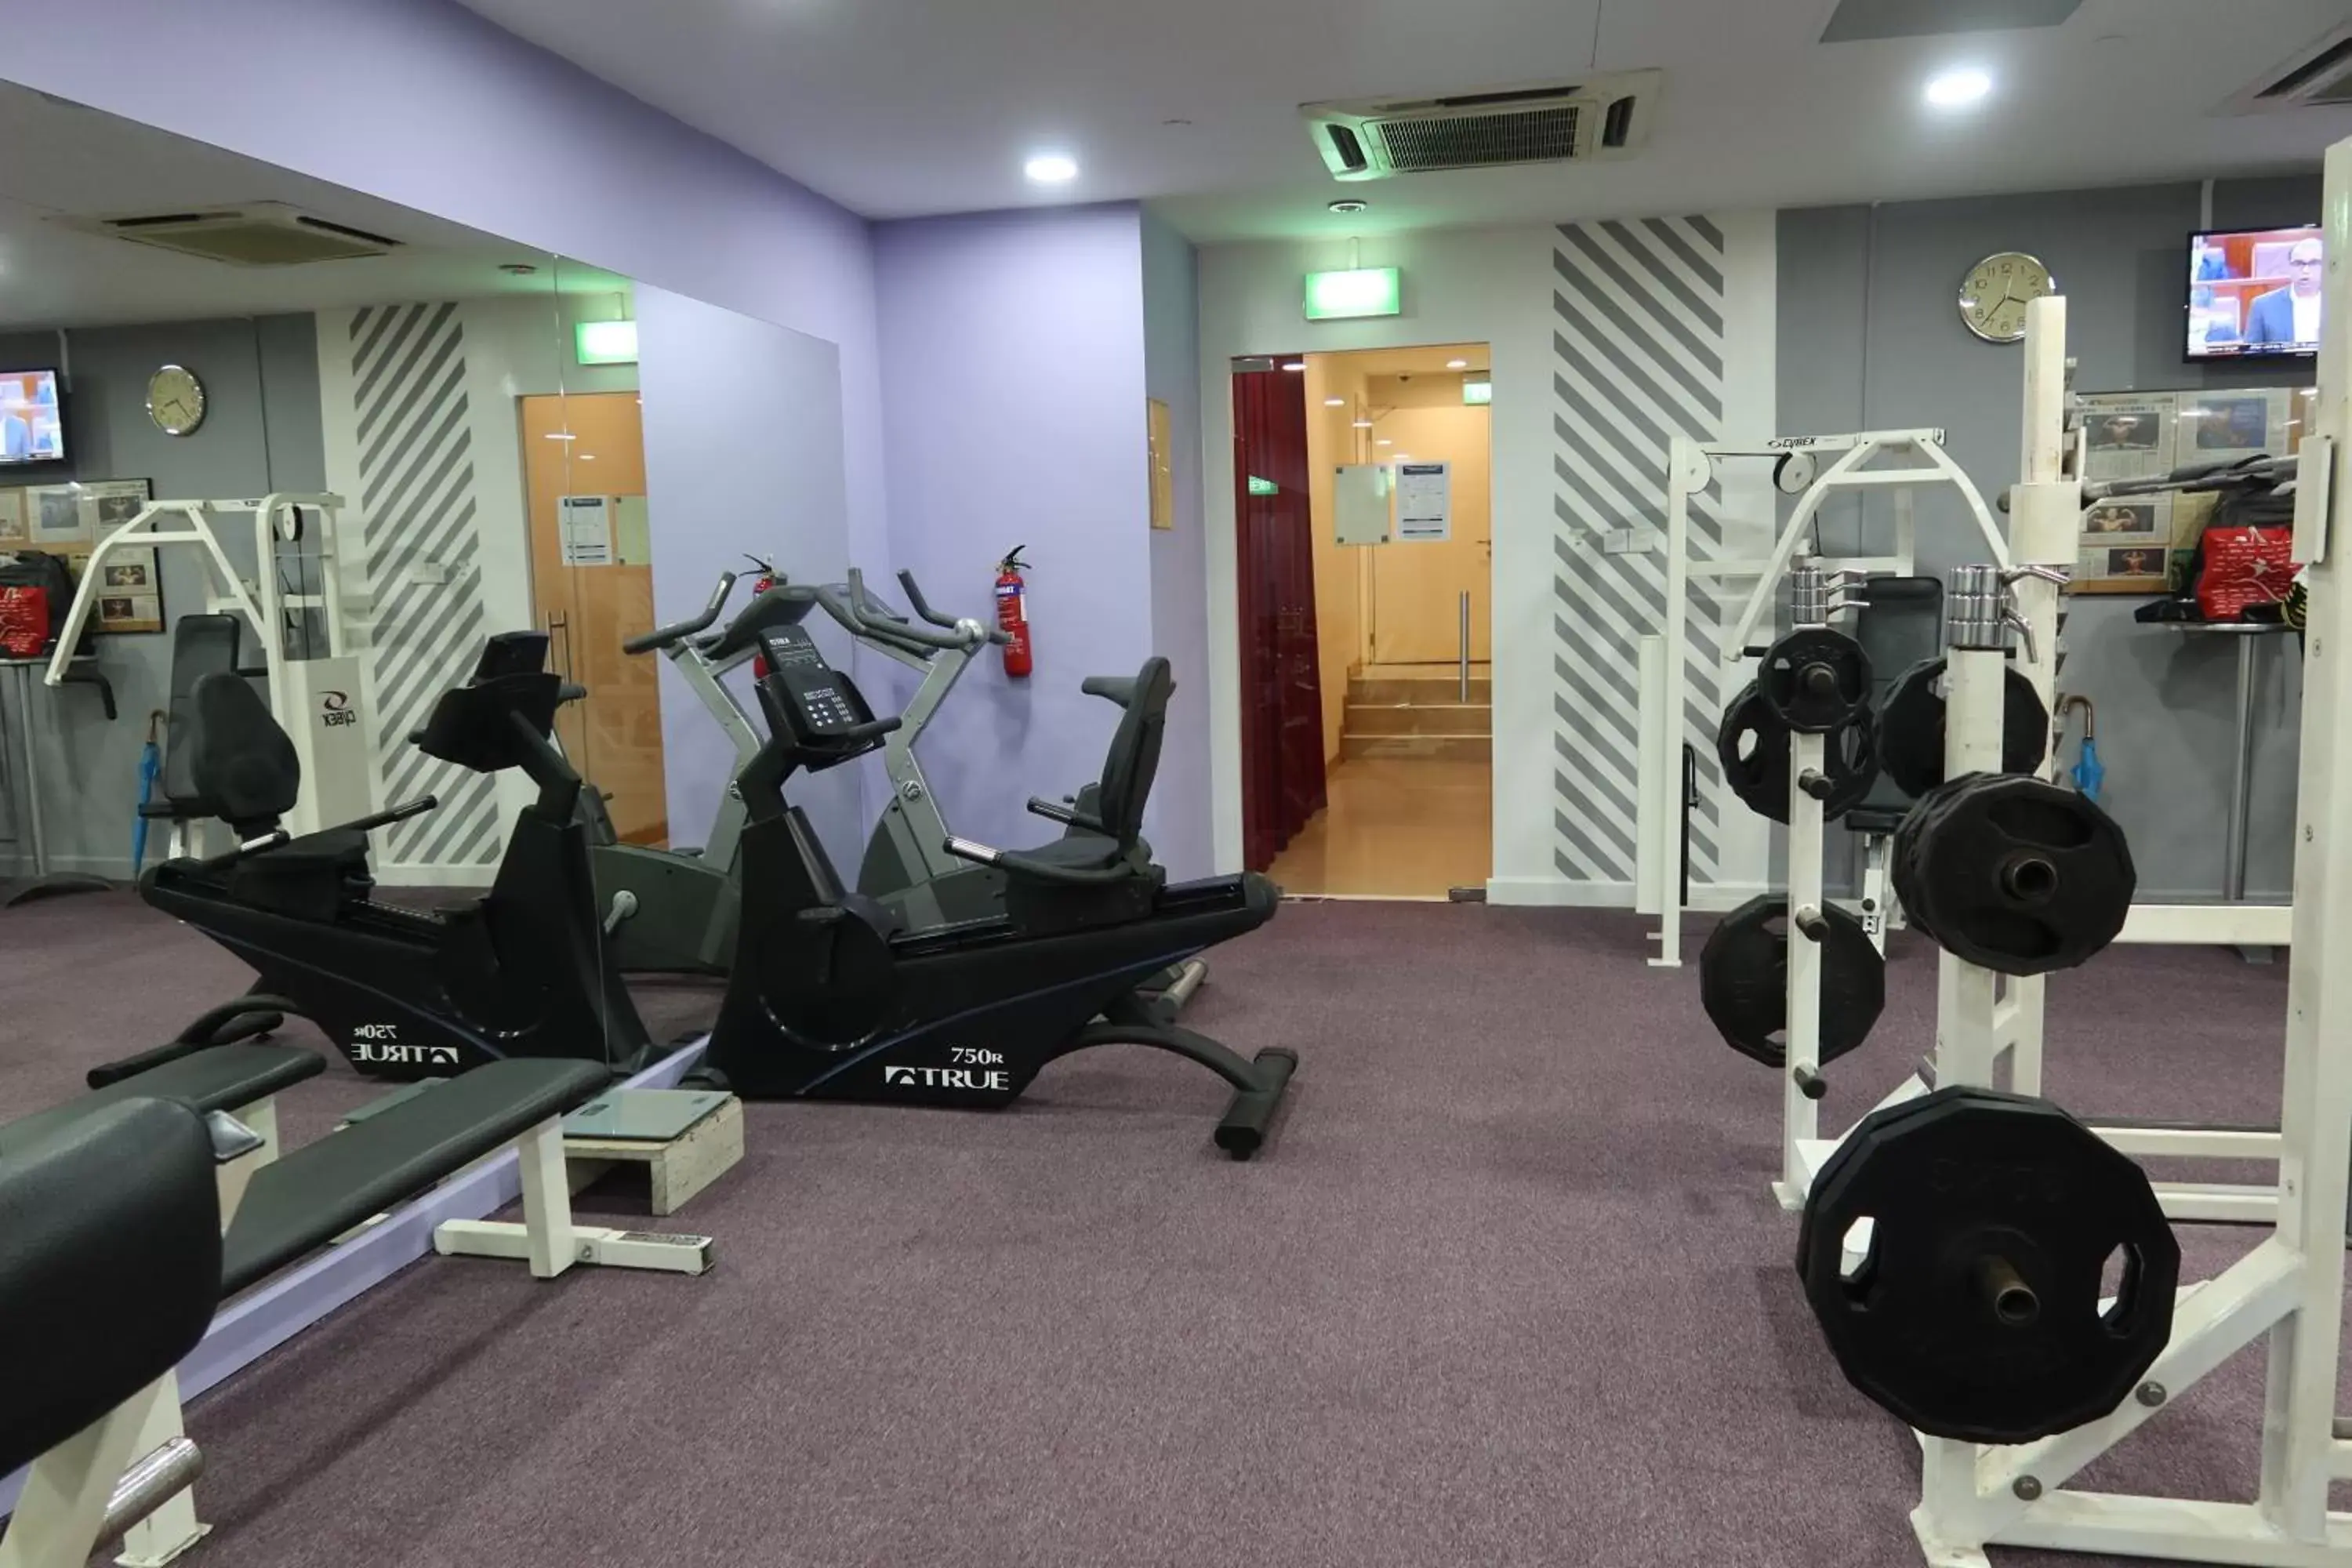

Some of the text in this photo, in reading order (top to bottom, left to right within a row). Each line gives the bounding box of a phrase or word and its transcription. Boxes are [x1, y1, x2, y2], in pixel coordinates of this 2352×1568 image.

[2001, 263, 2013, 275] 12
[2020, 265, 2025, 275] 1
[1976, 278, 1987, 289] 10
[2028, 274, 2040, 286] 2
[1976, 308, 1984, 319] 8
[2000, 321, 2010, 331] 6
[1783, 437, 1817, 448] CYBEX
[951, 1047, 1004, 1065] 750R
[917, 1067, 1009, 1091] TRUE
